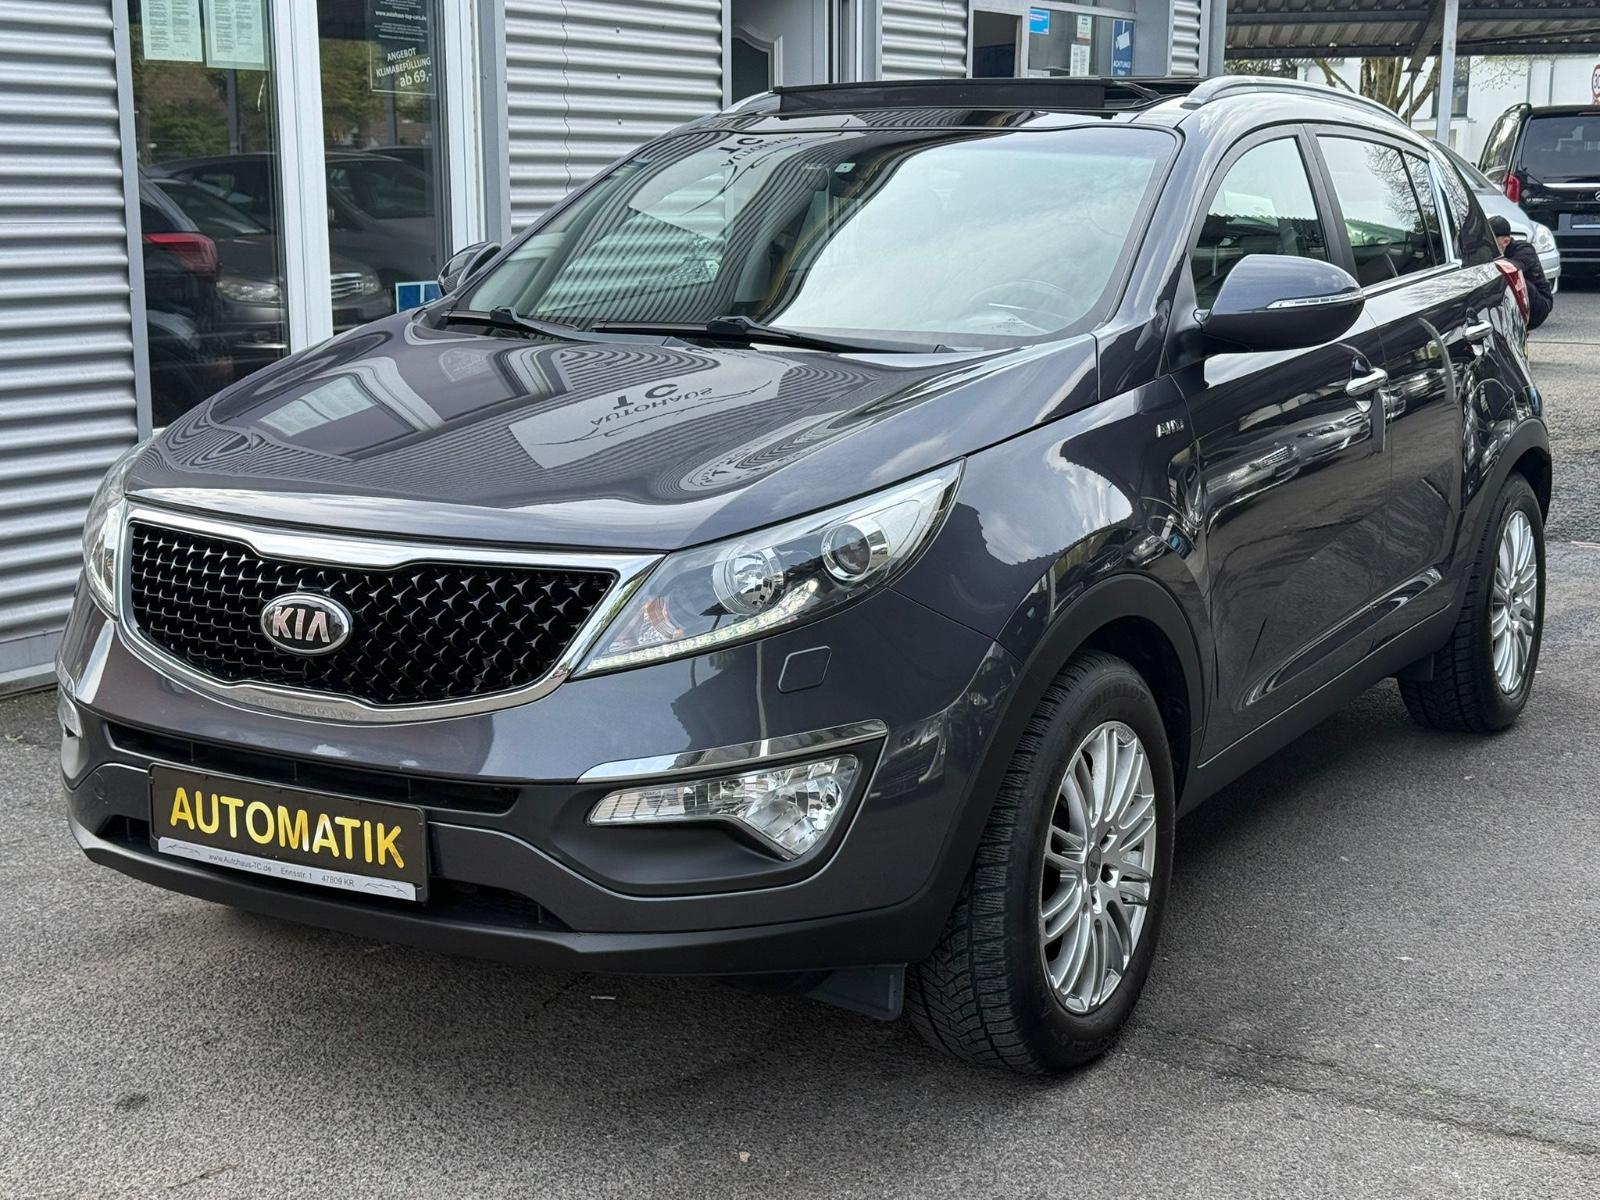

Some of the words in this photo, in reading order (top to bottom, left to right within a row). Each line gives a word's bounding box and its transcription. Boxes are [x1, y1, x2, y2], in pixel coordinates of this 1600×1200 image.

[375, 56, 431, 78] KLIMABEFÜLLUNG
[387, 47, 417, 62] ANGEBOT
[399, 72, 413, 88] ab
[413, 69, 432, 84] 69,-
[272, 606, 331, 643] KIA
[170, 787, 405, 869] AUTOMATIK
[208, 854, 273, 873] www.Autohaus-TC.de
[308, 872, 313, 880] 1
[321, 874, 343, 886] 47809
[342, 878, 355, 888] KR
